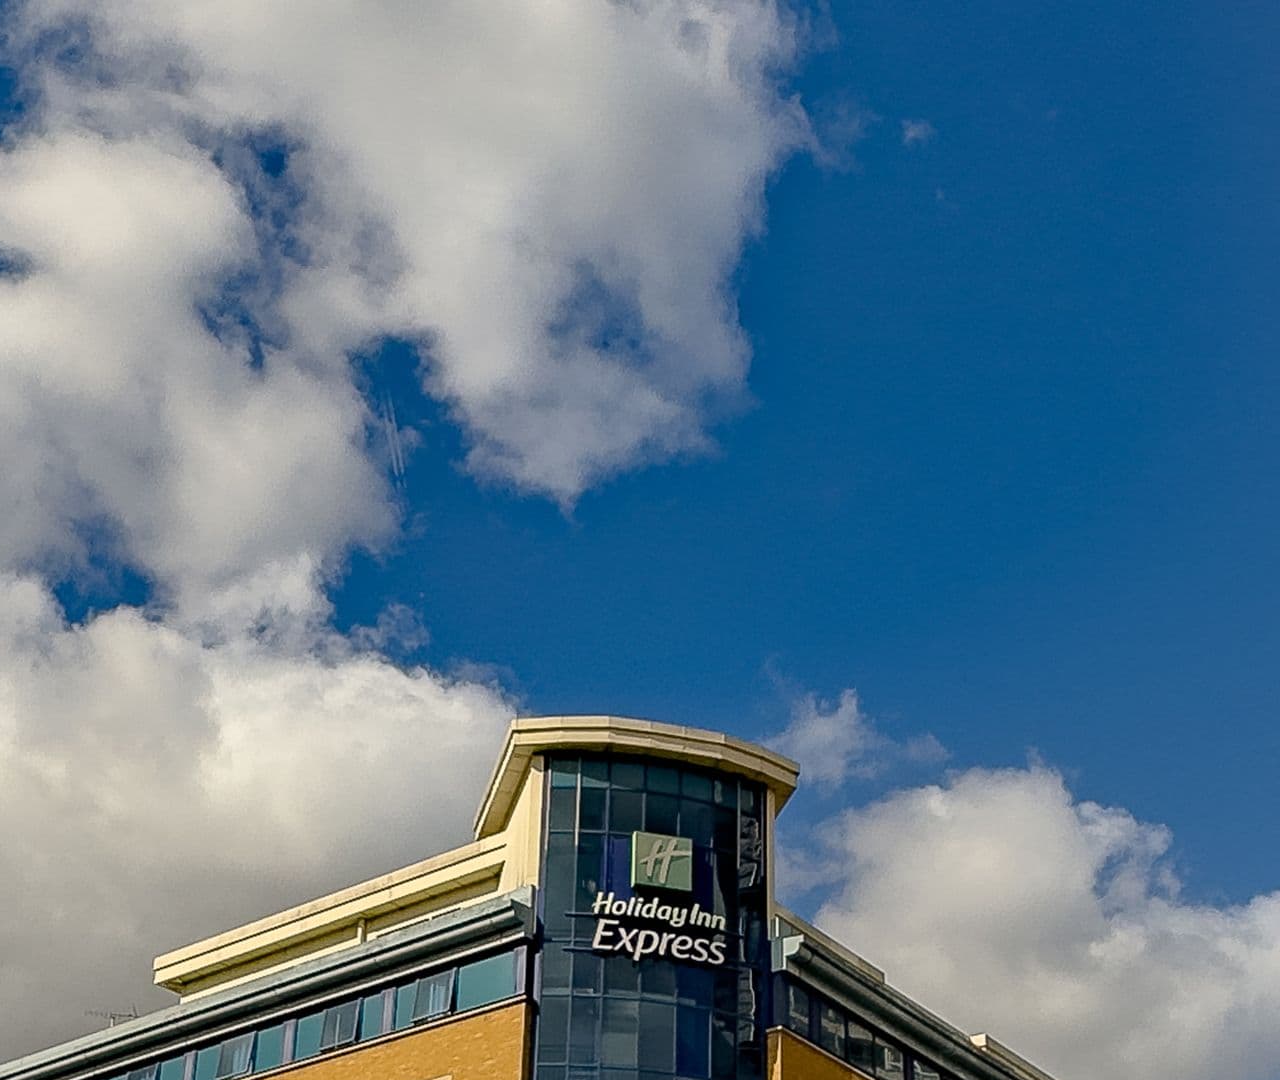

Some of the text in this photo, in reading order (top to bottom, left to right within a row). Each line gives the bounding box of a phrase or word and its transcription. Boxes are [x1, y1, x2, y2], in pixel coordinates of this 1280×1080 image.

[592, 892, 726, 930] Holiday Inn
[592, 918, 727, 965] Express
